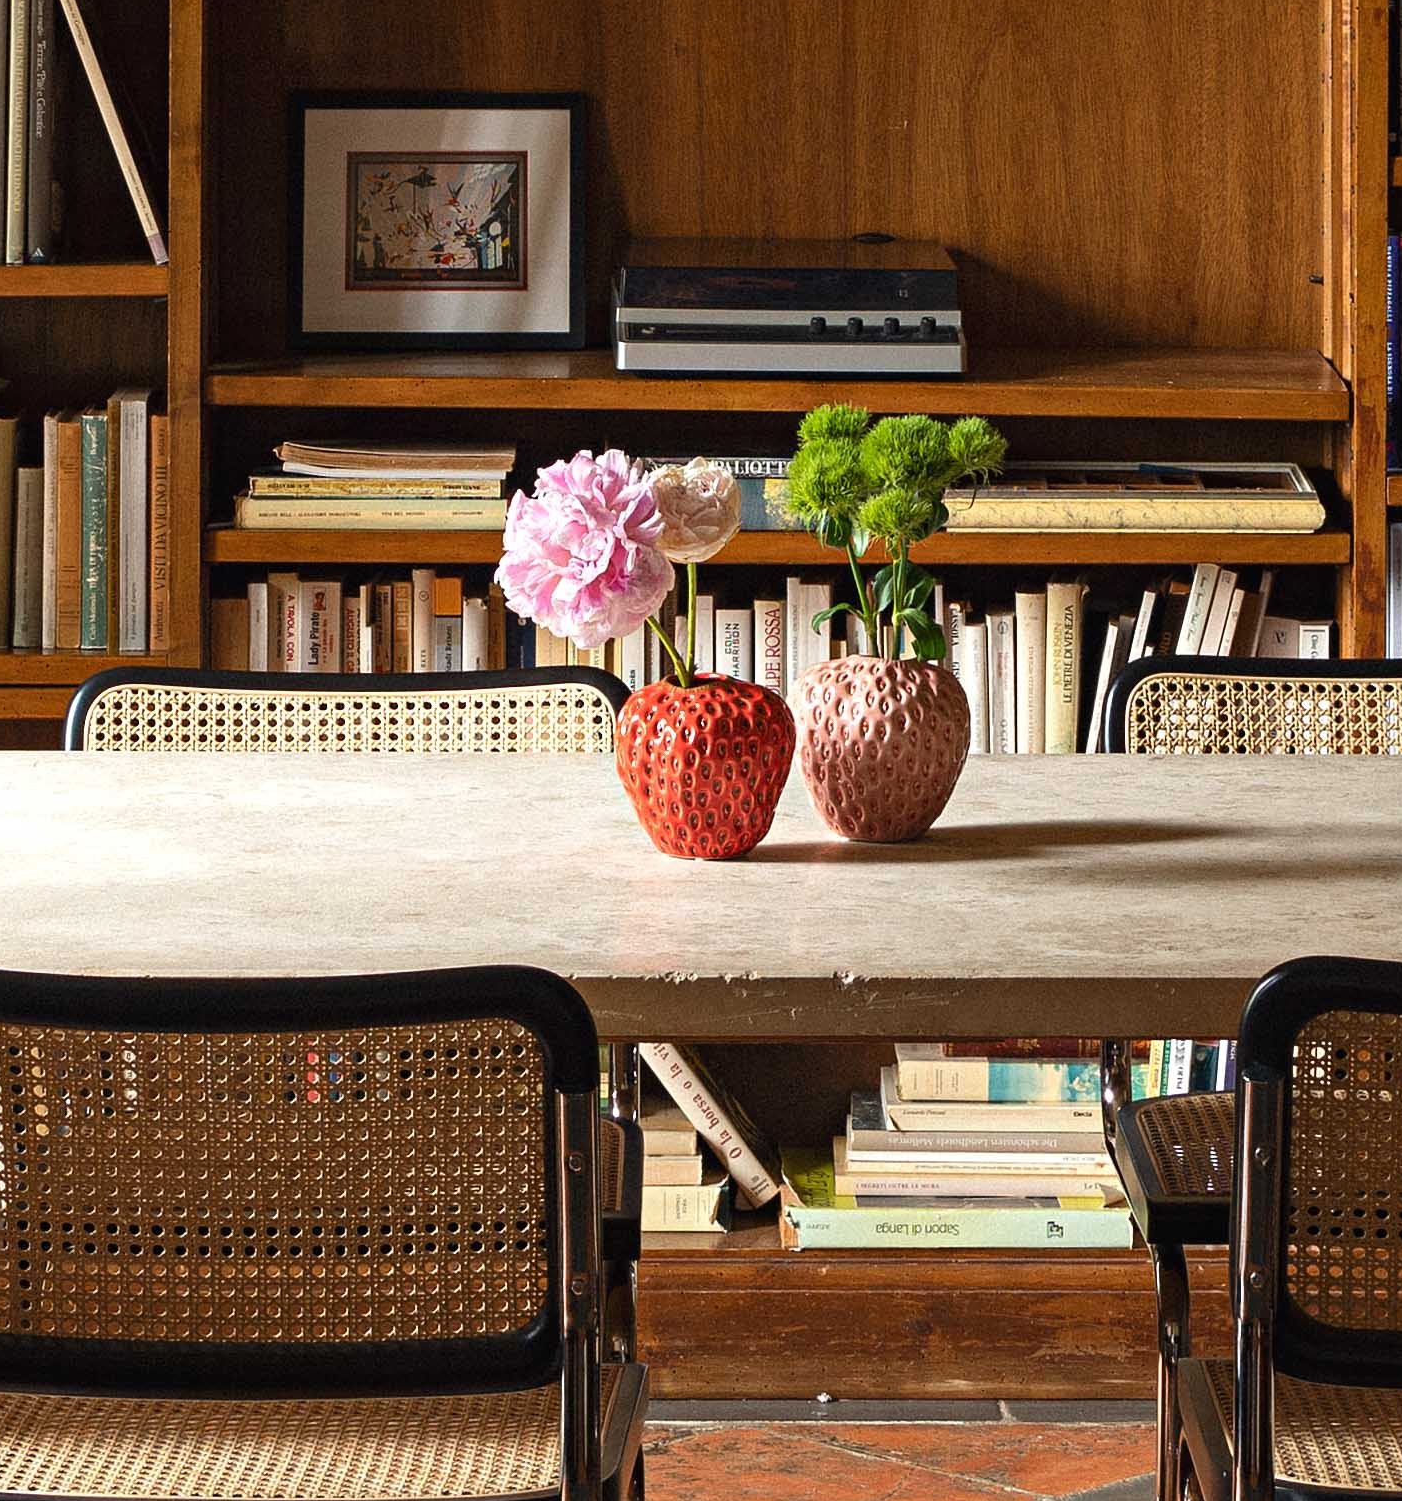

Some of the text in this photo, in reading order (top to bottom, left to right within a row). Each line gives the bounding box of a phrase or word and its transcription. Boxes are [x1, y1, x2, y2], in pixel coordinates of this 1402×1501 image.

[154, 466, 167, 480] III
[154, 484, 167, 528] VICINO
[154, 530, 167, 549] DA
[154, 555, 167, 589] VISTI
[308, 612, 321, 665] Lady Pirate
[724, 623, 732, 654] COLIN
[764, 608, 781, 657] ROSSA
[1062, 605, 1073, 703] LE PIETRE DI VENEZIA
[670, 1062, 684, 1078] la
[683, 1080, 693, 1091] o
[692, 1091, 720, 1129] borsa
[719, 1131, 733, 1147] la
[887, 1135, 1058, 1149] Die schönsten Landhotels Mallorcas
[732, 1148, 743, 1160] O
[875, 1222, 959, 1238] Sapori di Langa
